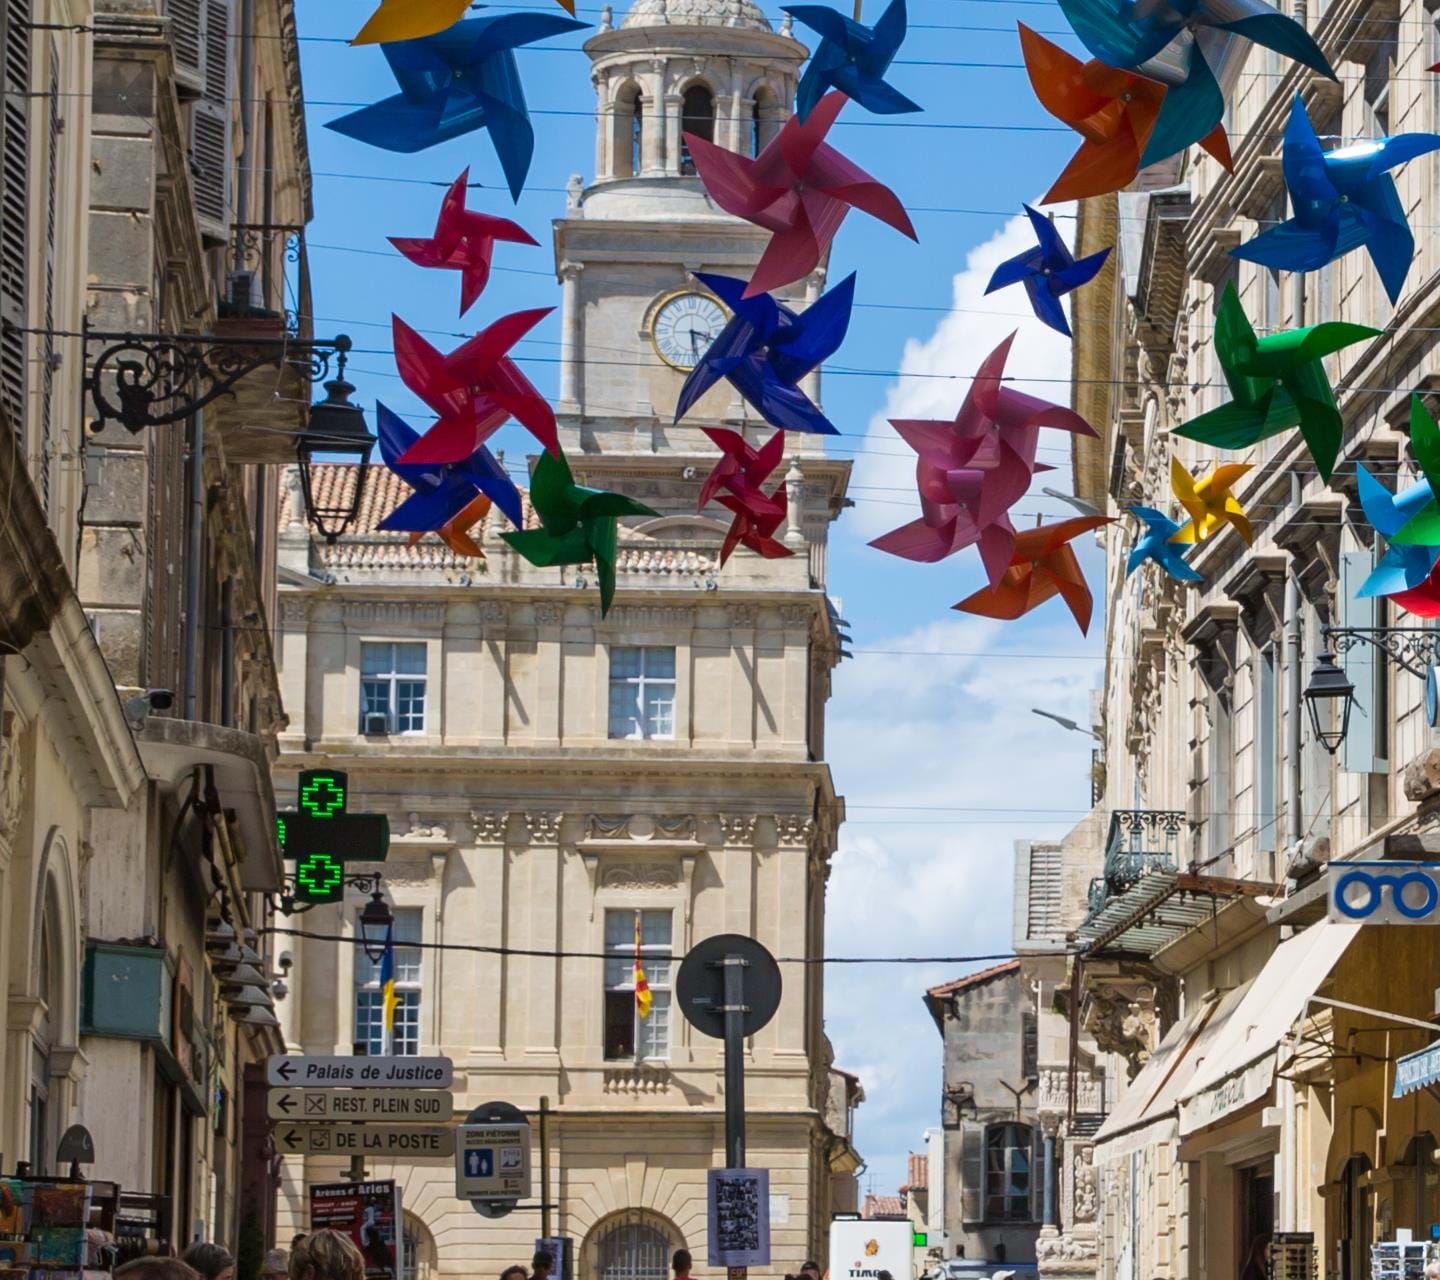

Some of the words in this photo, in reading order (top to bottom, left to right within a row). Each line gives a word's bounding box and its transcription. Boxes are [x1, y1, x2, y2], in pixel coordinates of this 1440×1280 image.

[306, 1064, 354, 1080] Palais
[361, 1064, 380, 1080] de
[386, 1064, 443, 1081] Justice
[333, 1097, 368, 1113] REST.
[373, 1098, 409, 1113] PLEIN
[414, 1098, 440, 1114] SUD
[337, 1133, 357, 1148] DE
[363, 1133, 382, 1149] LA
[388, 1133, 440, 1150] POSTE
